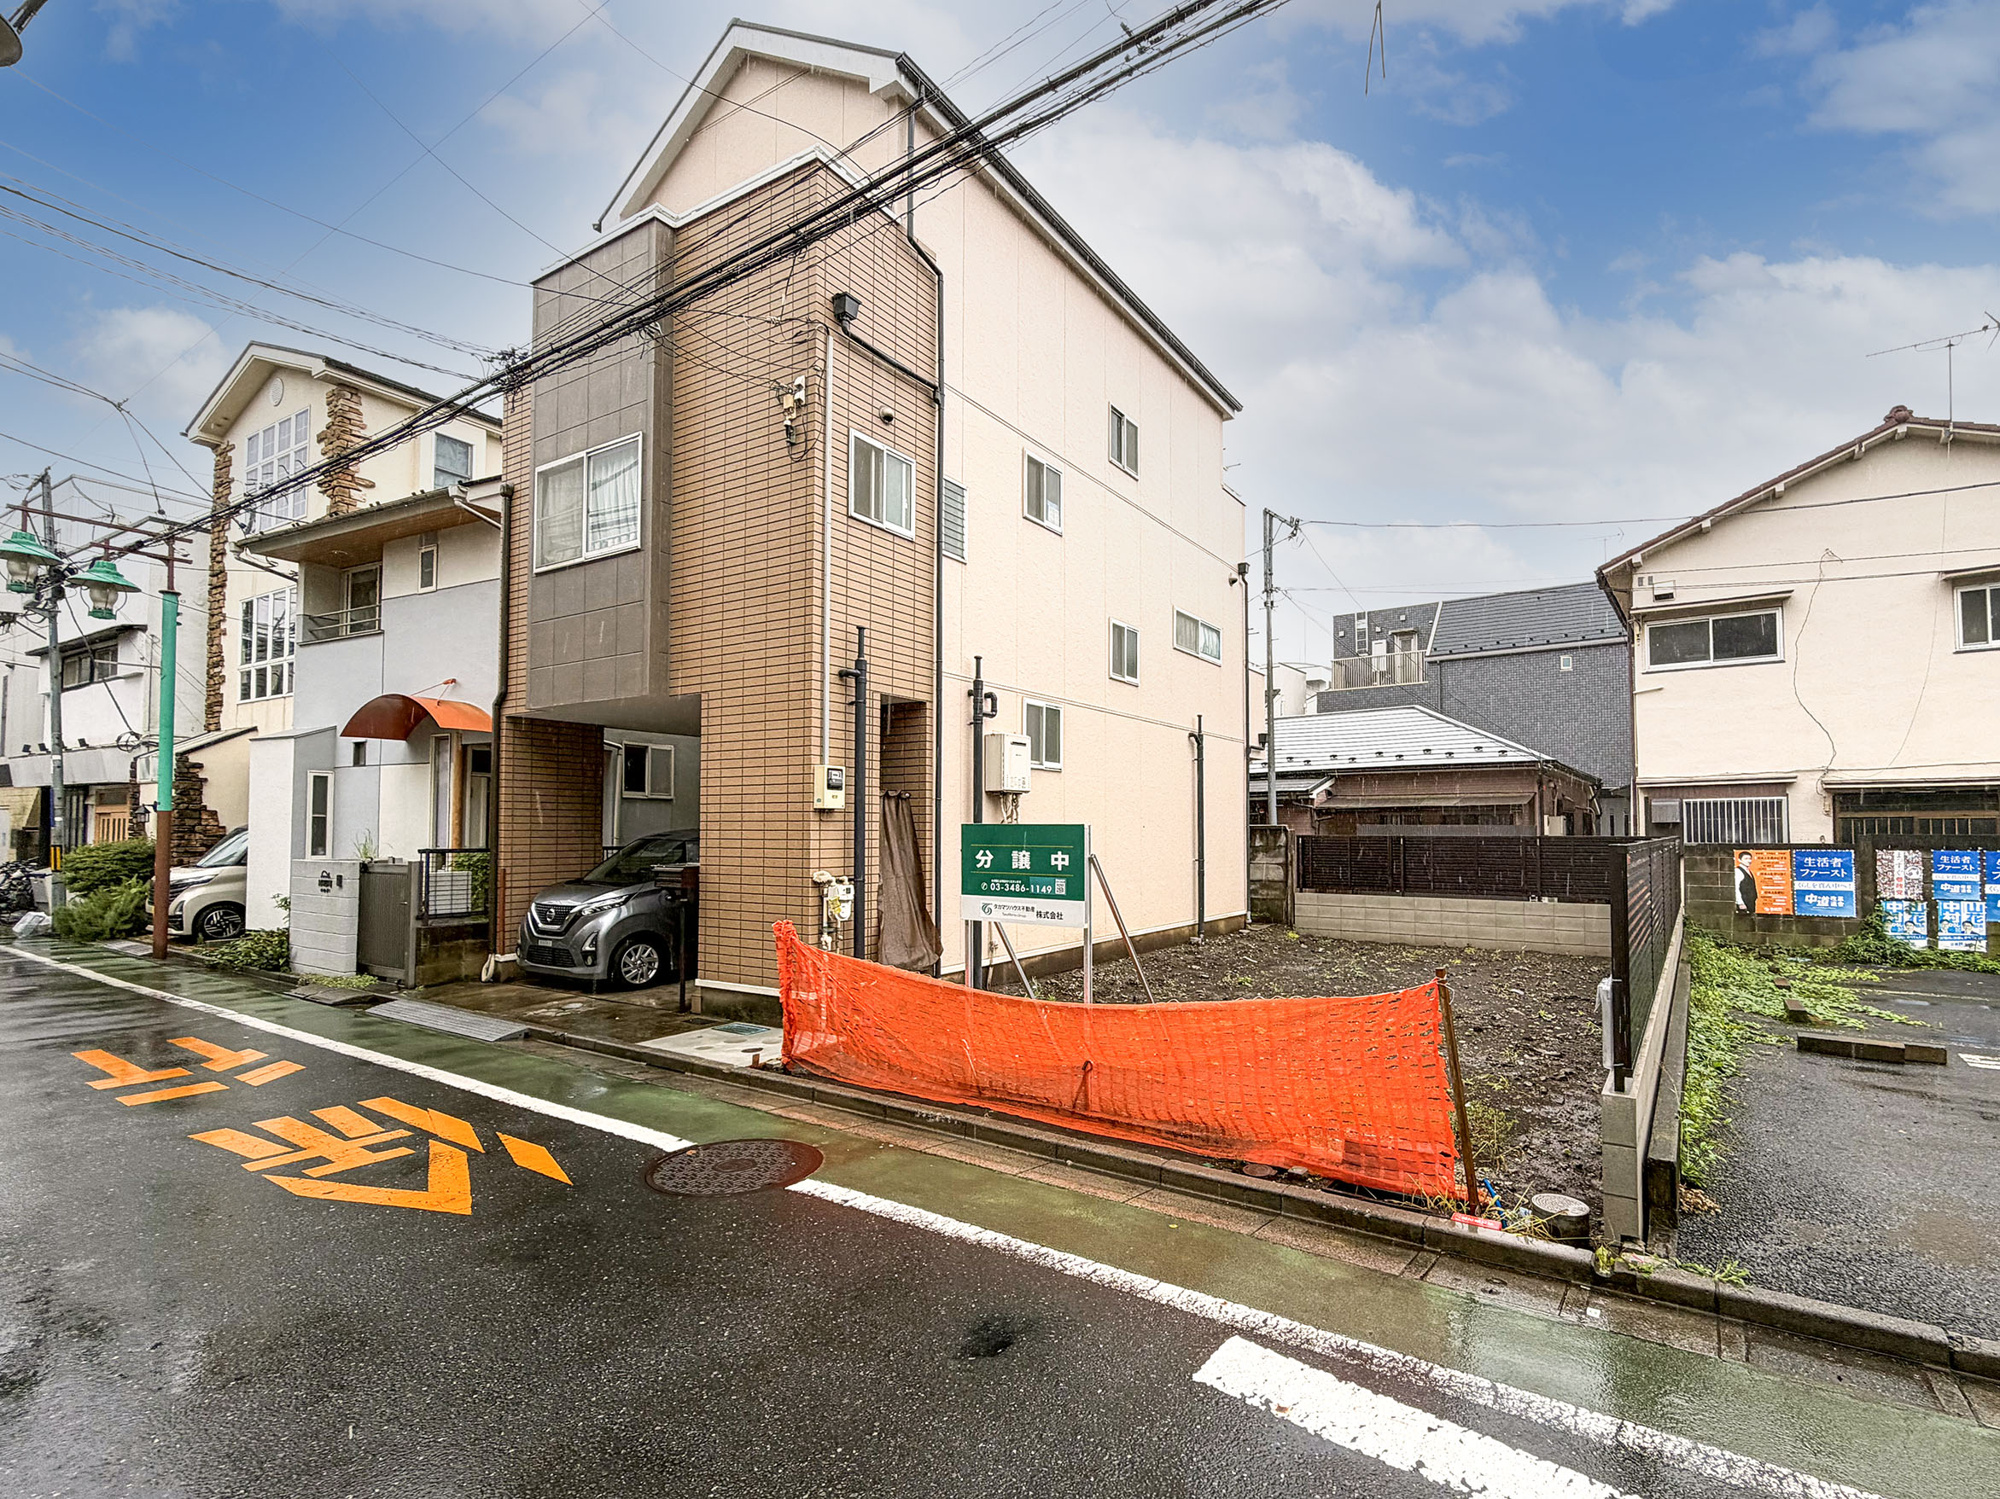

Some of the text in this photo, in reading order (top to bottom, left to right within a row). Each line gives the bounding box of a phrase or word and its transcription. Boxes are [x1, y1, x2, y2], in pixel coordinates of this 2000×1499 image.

[975, 849, 1070, 871] 分譲中
[1803, 857, 1843, 868] 生活者
[1940, 855, 1971, 864] 生活者
[1800, 868, 1847, 878] ファースト
[990, 882, 1052, 894] 03-3486-1149
[1036, 910, 1064, 920] 株式会社
